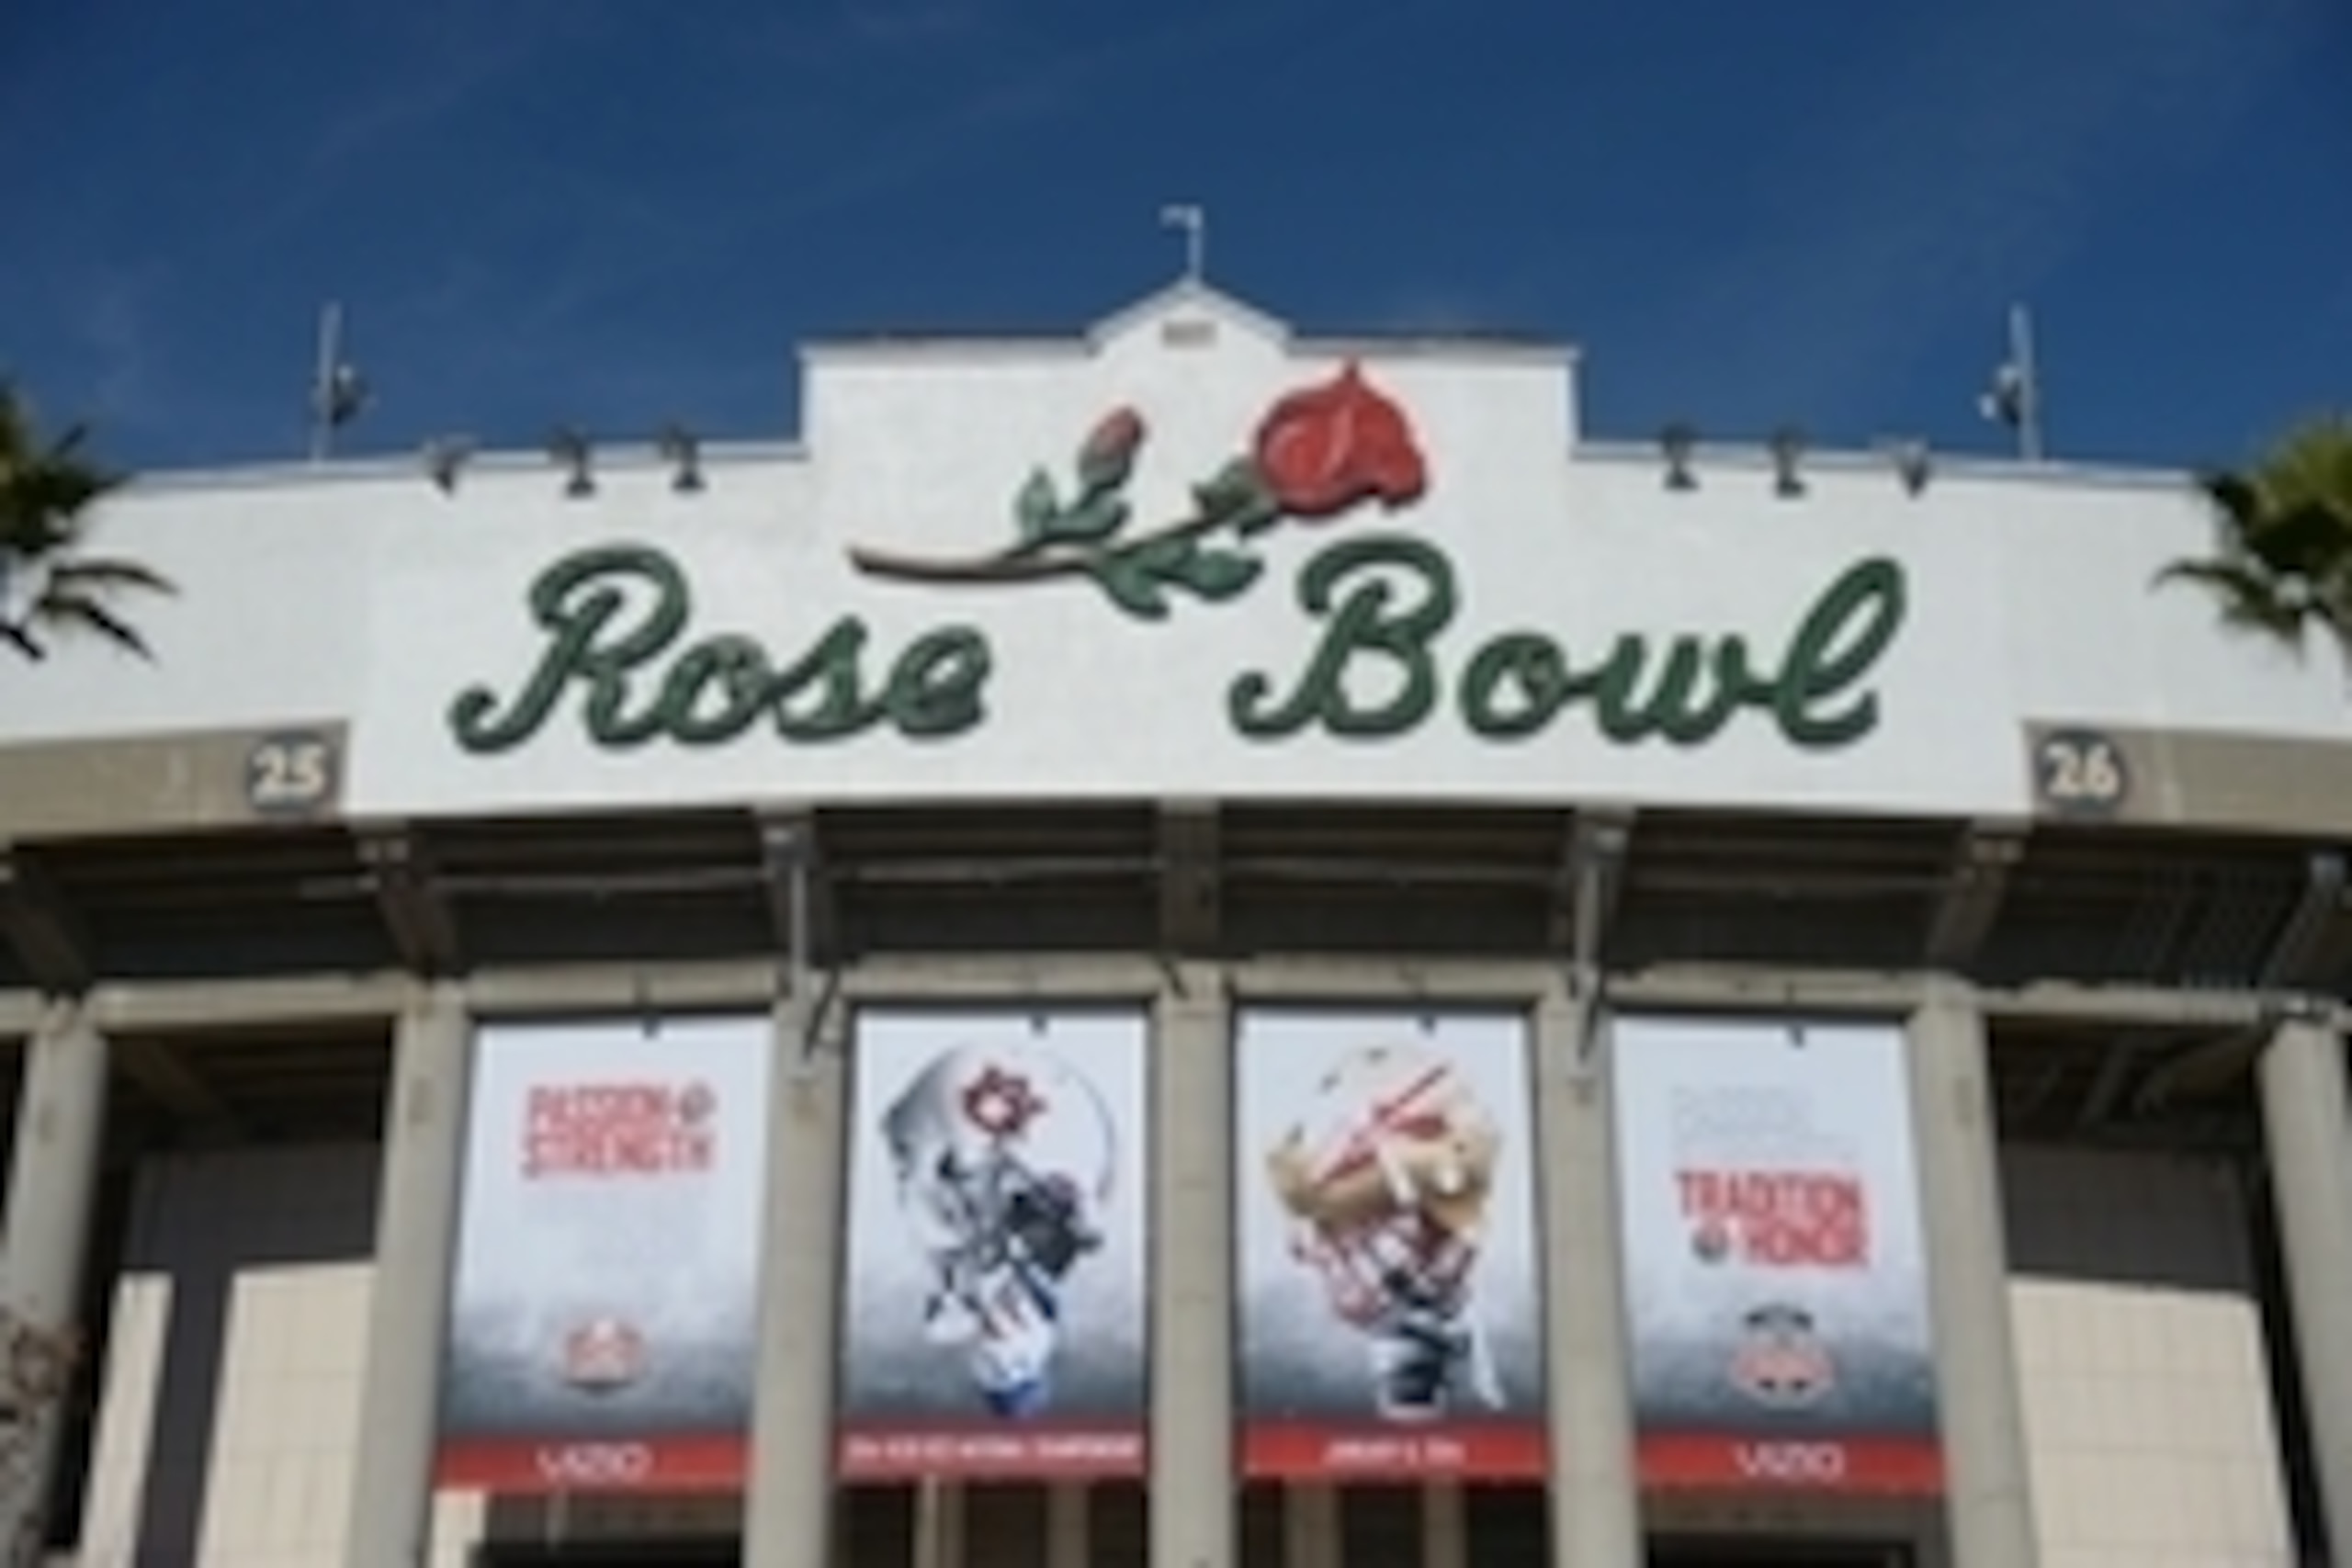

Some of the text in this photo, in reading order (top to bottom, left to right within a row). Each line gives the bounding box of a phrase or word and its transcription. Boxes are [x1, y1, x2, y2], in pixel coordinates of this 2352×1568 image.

[447, 535, 1908, 754] Rose Bowl
[252, 741, 327, 802] 25
[2044, 741, 2120, 799] 26
[1675, 1170, 1864, 1222] TRADITION
